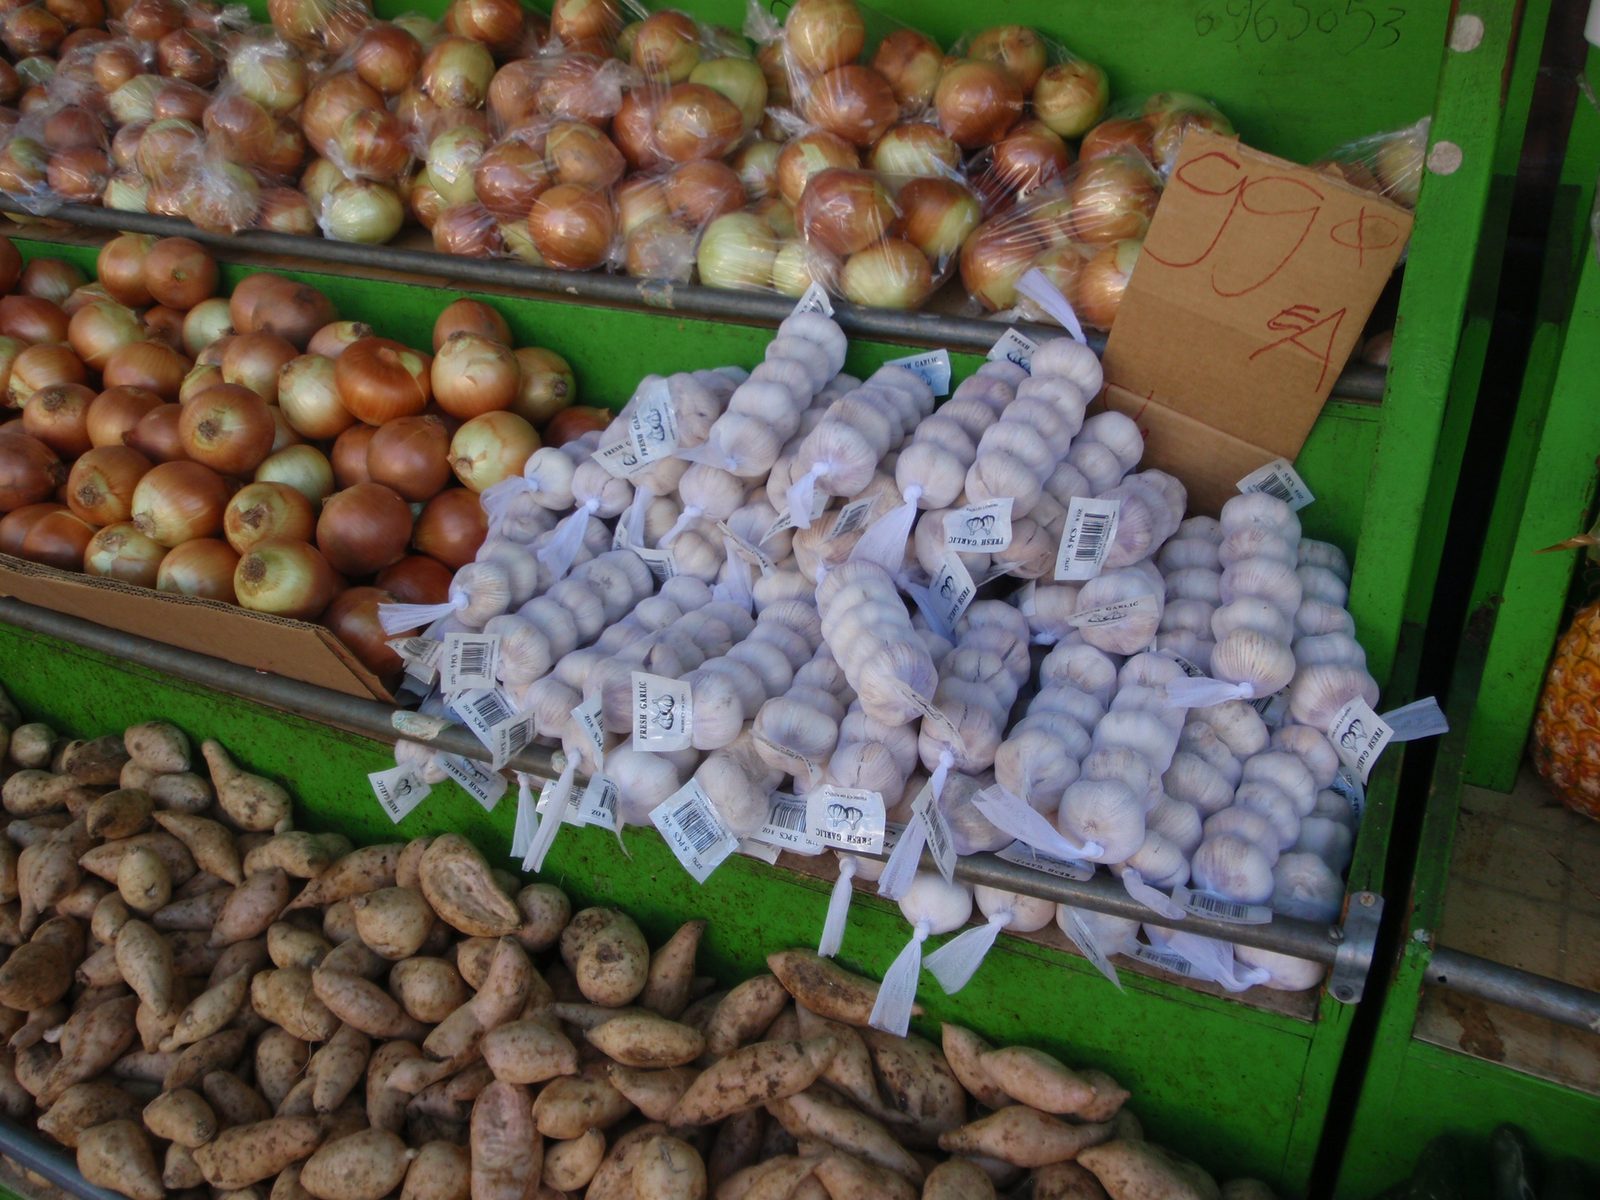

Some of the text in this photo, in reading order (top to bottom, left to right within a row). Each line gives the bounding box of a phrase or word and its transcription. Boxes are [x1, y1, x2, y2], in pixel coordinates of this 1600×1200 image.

[636, 433, 648, 456] FRESH
[948, 536, 1003, 545] FRESH GARLIC
[1068, 526, 1077, 543] PCS
[957, 586, 970, 605] FRESH
[1105, 600, 1138, 610] GARLIC
[638, 681, 646, 708] GARLIC
[1367, 727, 1384, 750] FRESH
[442, 759, 468, 781] GARLIC
[467, 780, 488, 800] FRESH
[672, 831, 685, 846] PCS
[778, 831, 792, 840] PCS
[815, 828, 841, 841] GARLIC
[846, 834, 871, 845] FRESH
